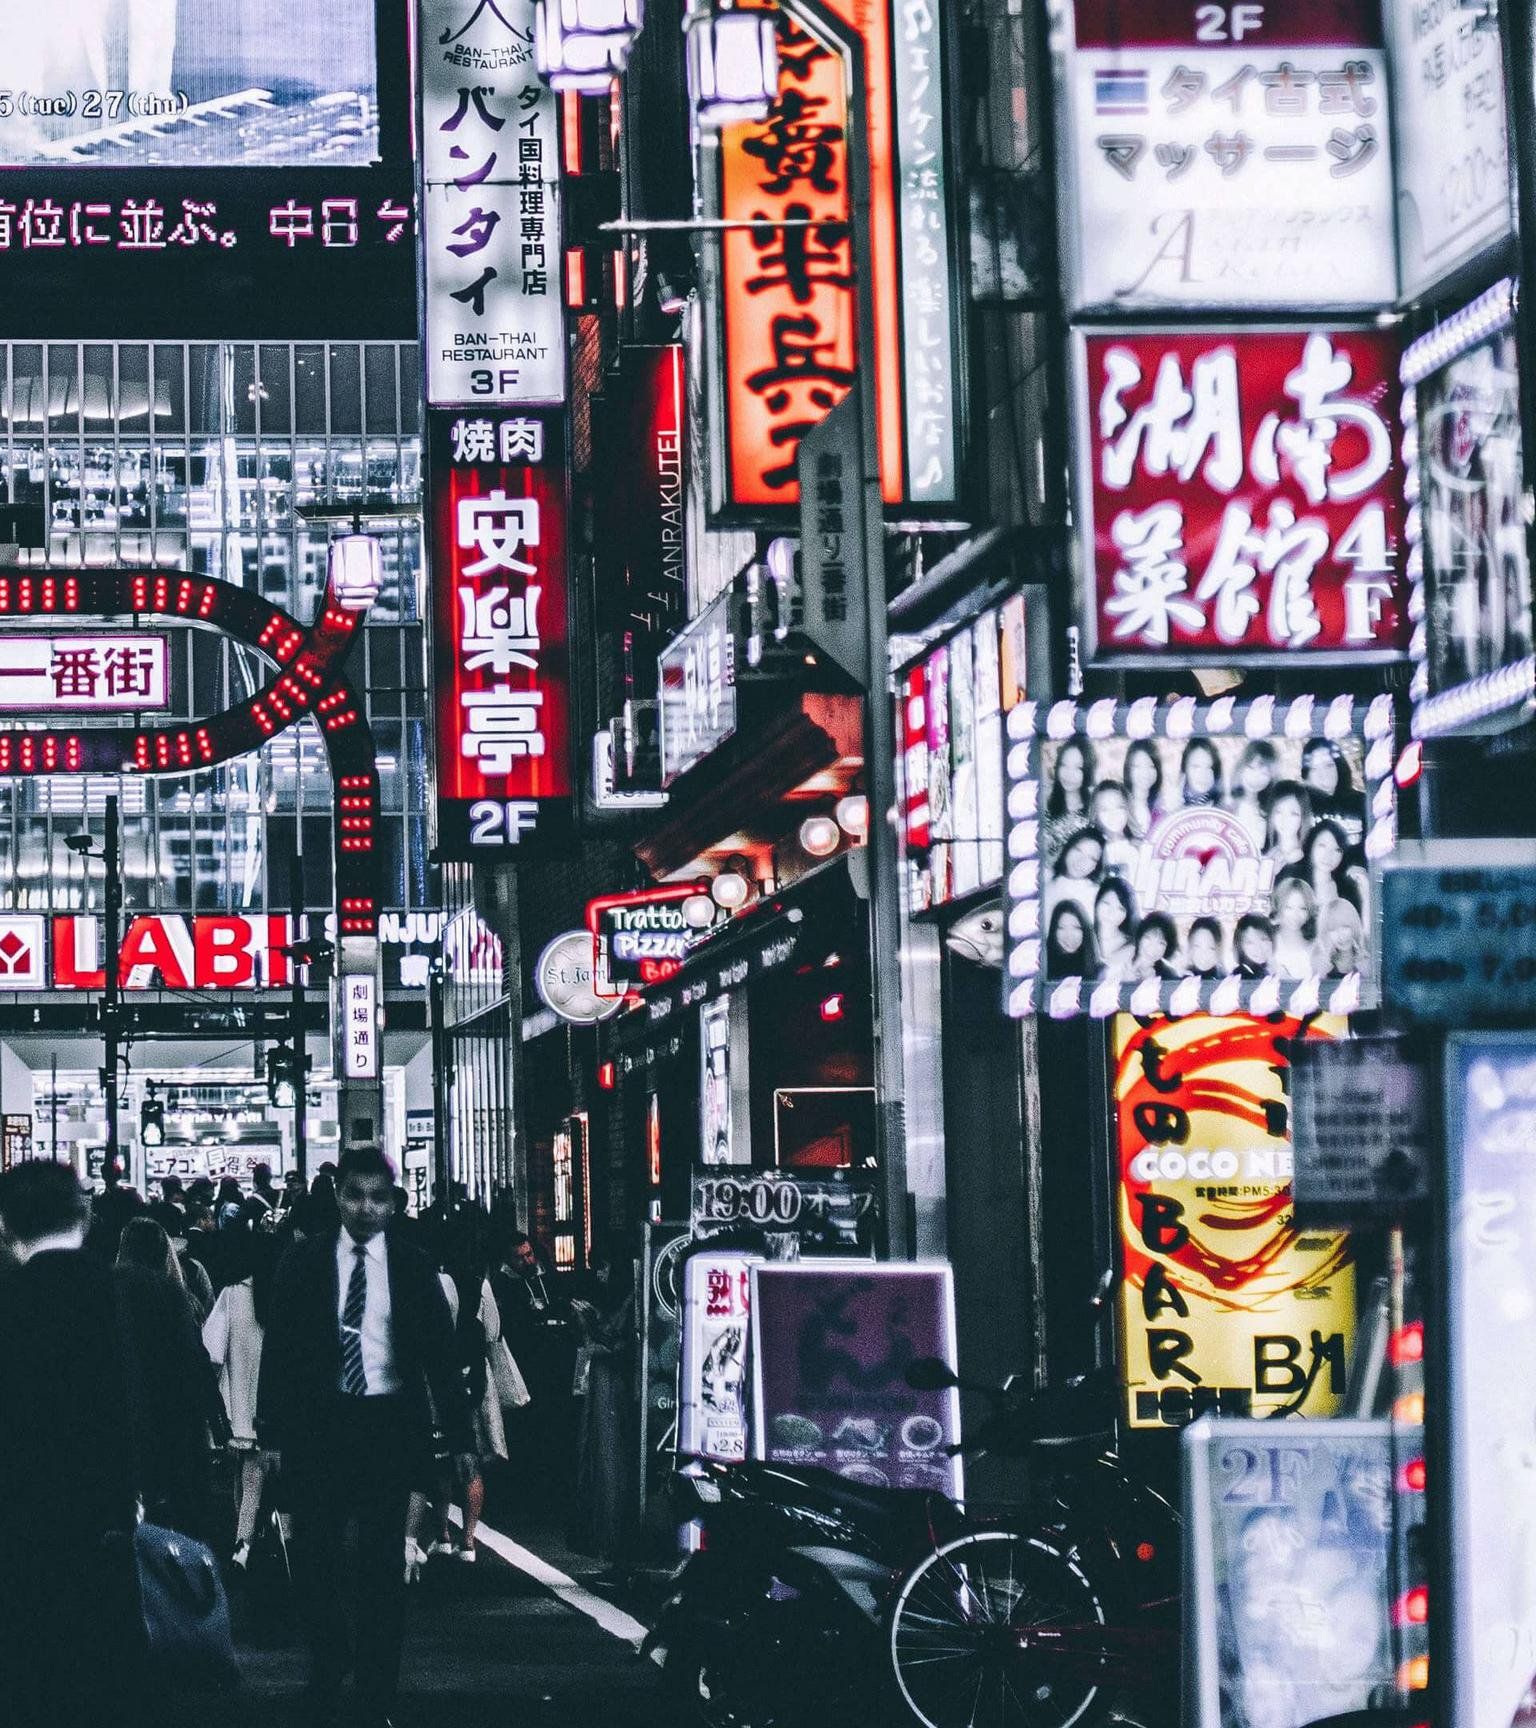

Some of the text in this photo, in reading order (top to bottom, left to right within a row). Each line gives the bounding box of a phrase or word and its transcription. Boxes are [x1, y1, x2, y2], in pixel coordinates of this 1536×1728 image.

[1195, 5, 1264, 41] 2F
[1162, 62, 1377, 118] タイ古式
[1097, 124, 1379, 182] マッサージ
[439, 86, 505, 316] バンタイ
[517, 85, 547, 297] タイ国料理専門店
[442, 347, 548, 362] RESTAURANT
[454, 332, 536, 345] BAN-THAI
[470, 370, 521, 395] 3F
[452, 419, 544, 462] 焼肉
[1100, 334, 1392, 502] 湖南
[657, 428, 682, 581] ANRAKUTEI
[1334, 503, 1398, 643] 4F
[458, 490, 545, 775] 安楽亭
[470, 801, 540, 845] 2F
[52, 915, 293, 988] LABI
[352, 985, 369, 1068] 劇場通り
[1131, 1150, 1294, 1182] COCO NE
[698, 1179, 802, 1223] 19:00
